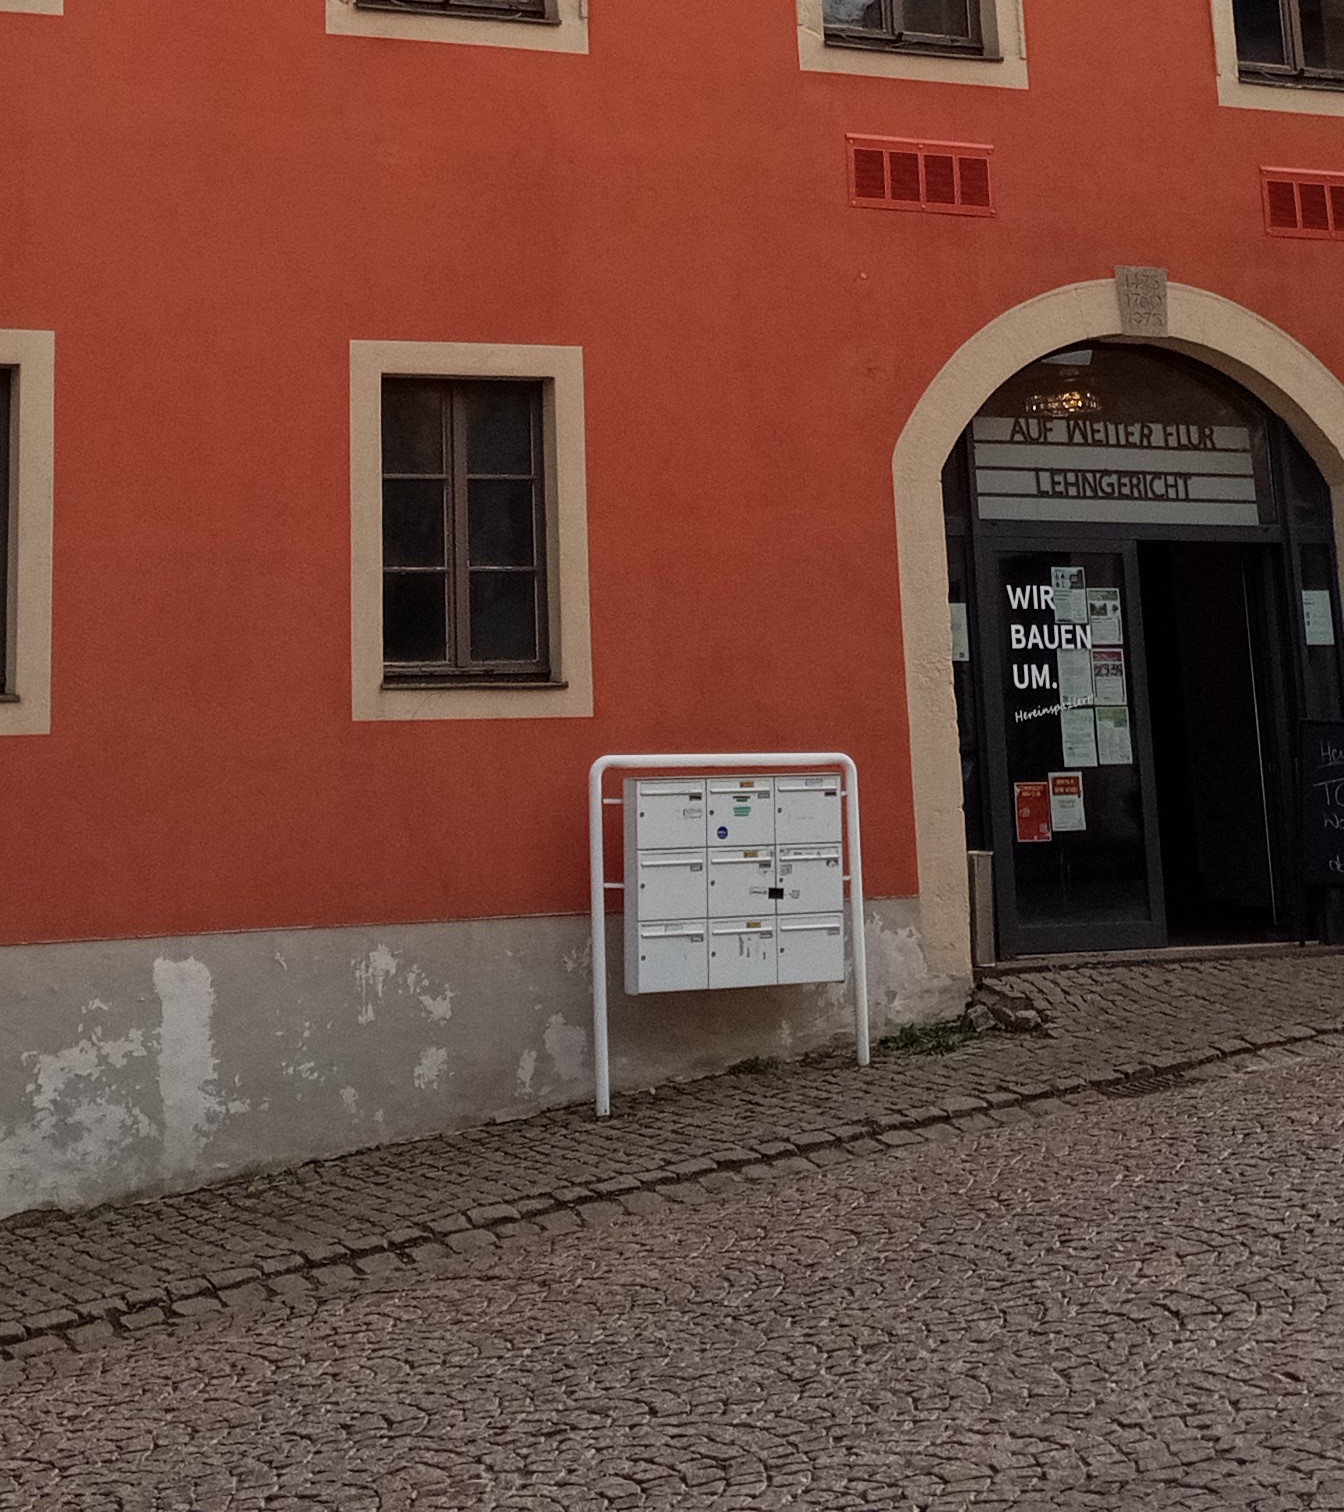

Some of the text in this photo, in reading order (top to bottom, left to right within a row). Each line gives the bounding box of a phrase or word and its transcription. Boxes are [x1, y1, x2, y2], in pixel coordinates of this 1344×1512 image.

[1010, 418, 1216, 450] AUF WEITER FLUR
[1036, 469, 1191, 500] LEHNGERICHT
[1006, 584, 1056, 610] WIR
[1010, 624, 1091, 650] BAUEN
[1012, 664, 1058, 690] UM.
